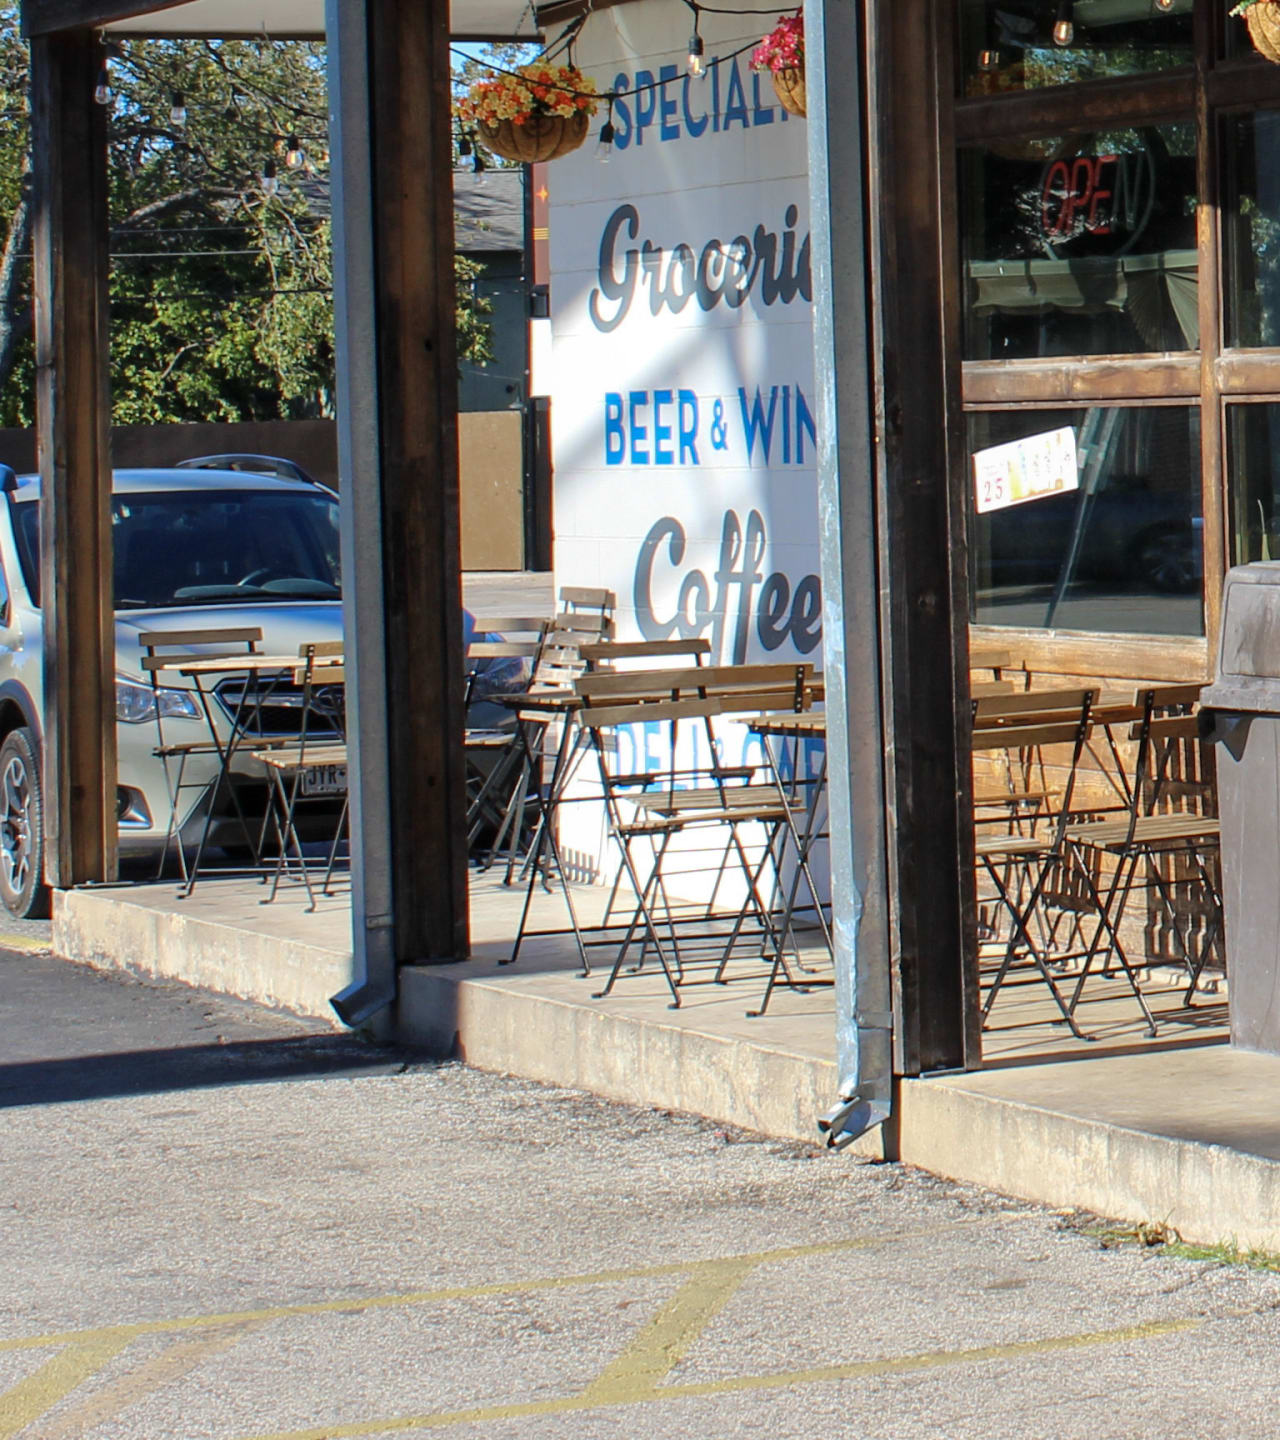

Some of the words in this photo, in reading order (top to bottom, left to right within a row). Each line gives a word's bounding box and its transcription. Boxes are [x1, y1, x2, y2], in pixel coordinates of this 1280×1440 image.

[613, 55, 789, 150] SPECIAL
[1042, 154, 1145, 237] OPEN
[588, 203, 813, 334] Groceri
[605, 388, 701, 466] BEER
[710, 398, 730, 451] &
[738, 382, 818, 468] WIN
[633, 508, 823, 668] Coffee
